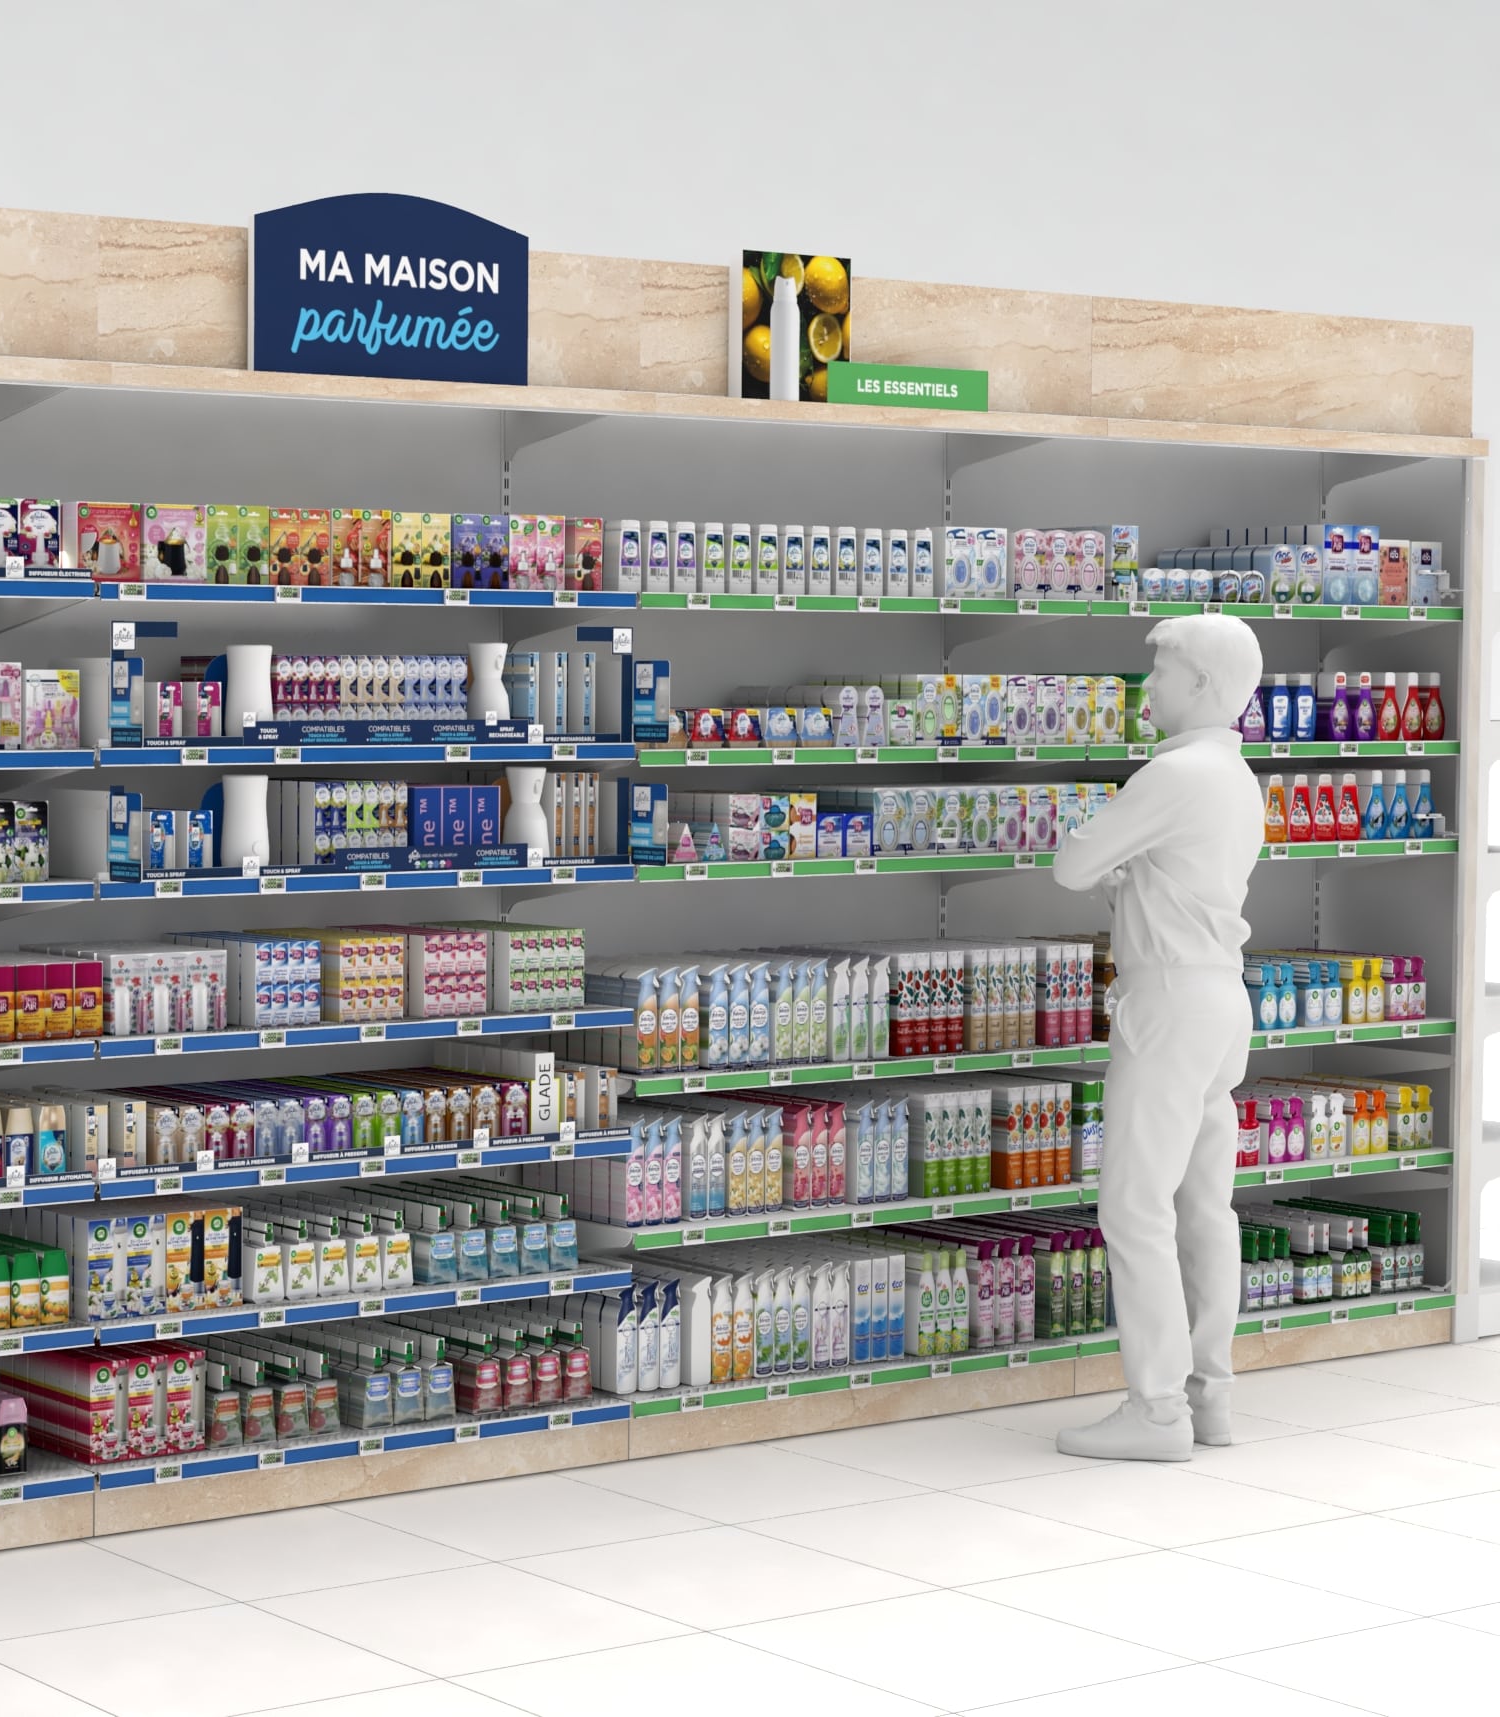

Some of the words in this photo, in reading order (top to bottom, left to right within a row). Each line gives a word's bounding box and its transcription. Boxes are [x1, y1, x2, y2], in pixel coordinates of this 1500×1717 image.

[300, 248, 353, 284] MA
[365, 253, 499, 294] MAISON
[291, 299, 499, 355] parfumée
[857, 379, 880, 393] LES
[884, 381, 958, 397] ESSENTIELS
[347, 852, 390, 860] COMPATIBLES
[539, 1063, 551, 1121] GLADE
[121, 1168, 148, 1176] DIFFUSEUR
